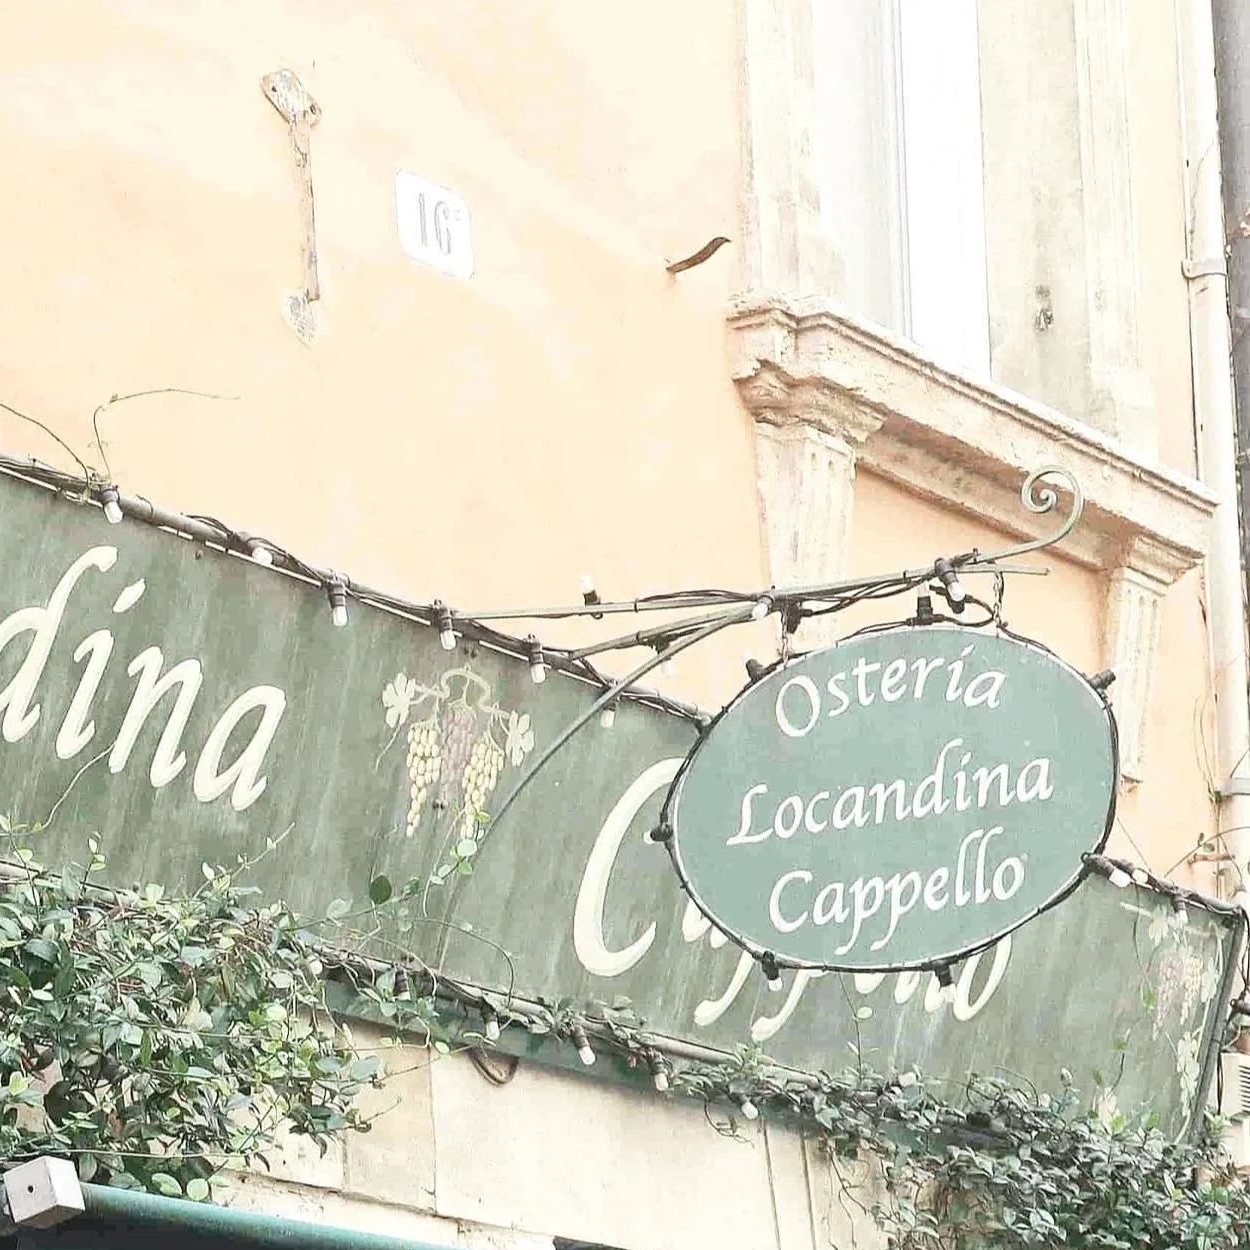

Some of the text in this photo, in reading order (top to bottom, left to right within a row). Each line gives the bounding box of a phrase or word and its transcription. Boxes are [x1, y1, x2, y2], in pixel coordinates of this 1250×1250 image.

[418, 192, 452, 256] 16
[775, 644, 1008, 737] Osteria
[726, 737, 1054, 846] Locandina
[768, 826, 1026, 956] Cappello
